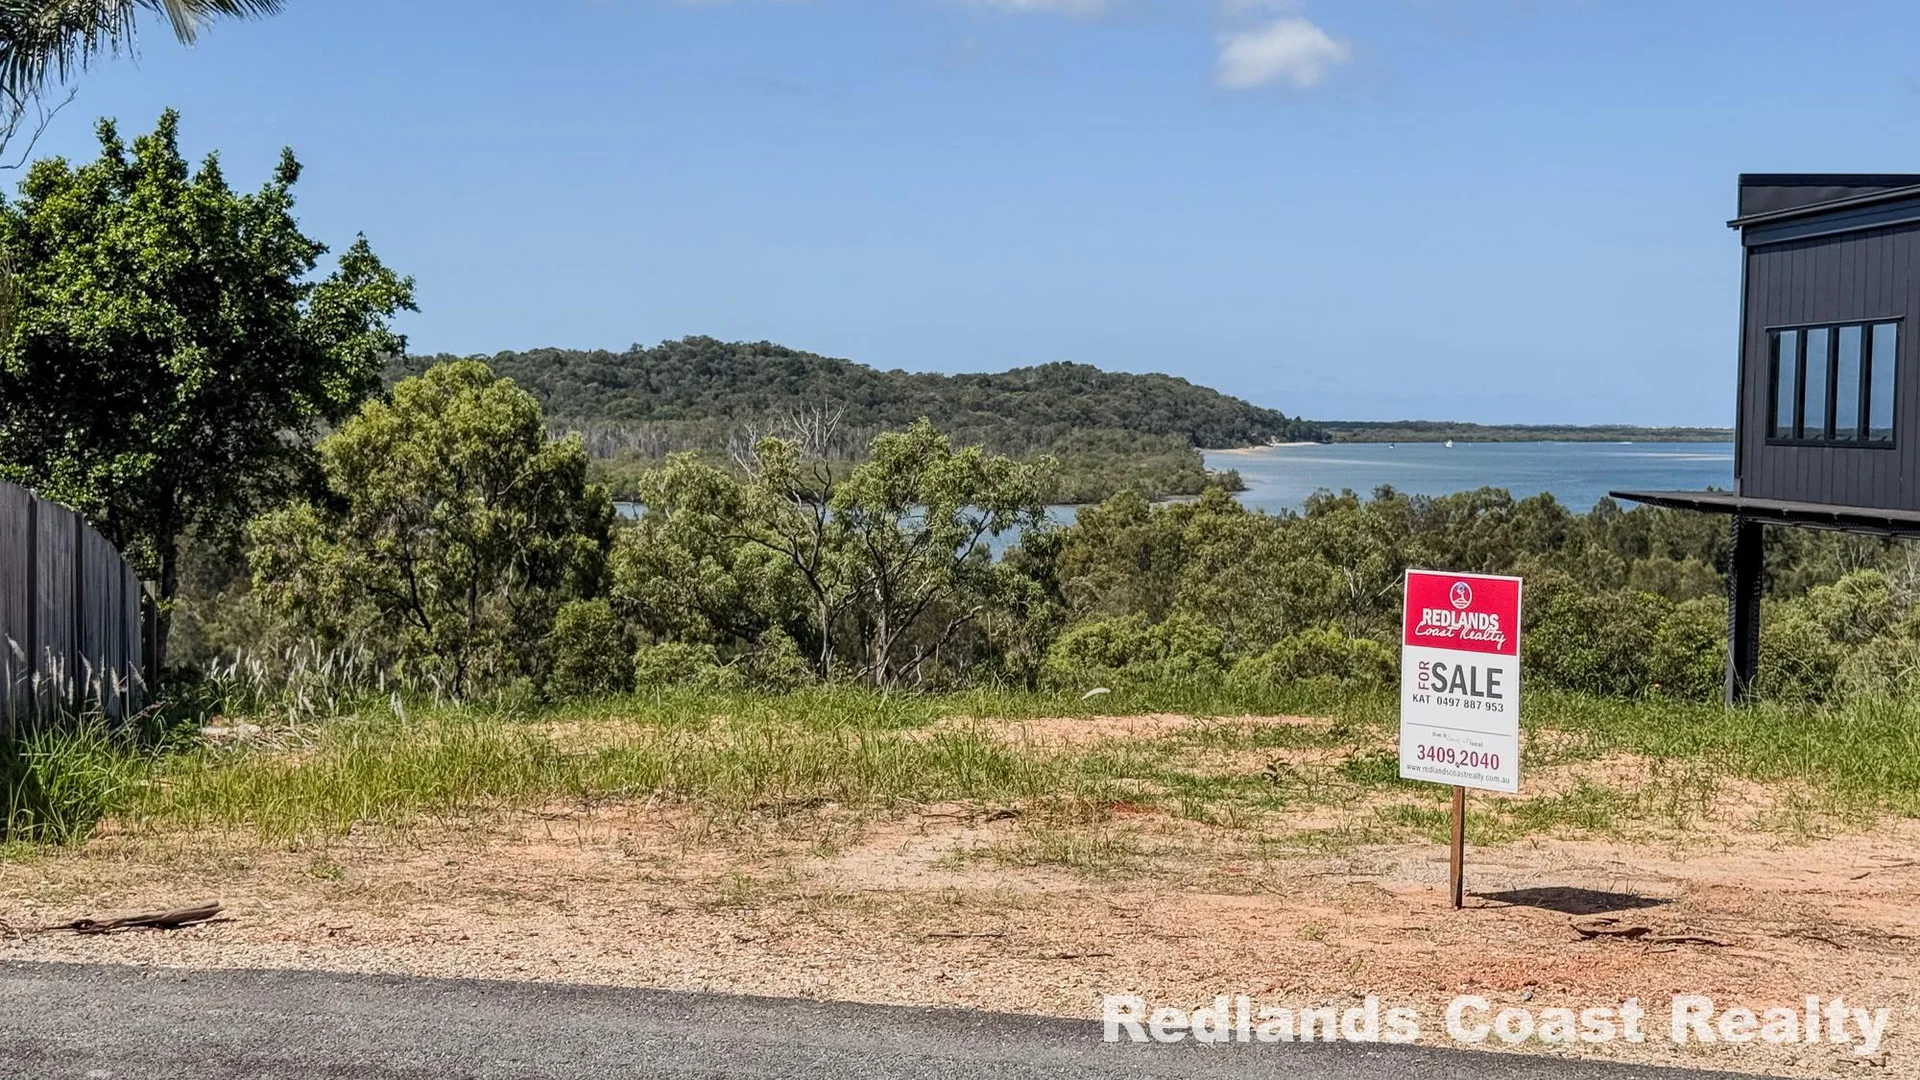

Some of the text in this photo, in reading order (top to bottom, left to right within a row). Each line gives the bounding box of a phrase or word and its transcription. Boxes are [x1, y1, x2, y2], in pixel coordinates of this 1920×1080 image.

[1422, 608, 1499, 631] REDLANDS
[1415, 621, 1506, 651] Coast Realty
[1418, 661, 1430, 690] FOR
[1431, 662, 1503, 699] SALE
[1412, 694, 1504, 713] KAT 0497 887 953
[1417, 744, 1500, 770] 3409 2040
